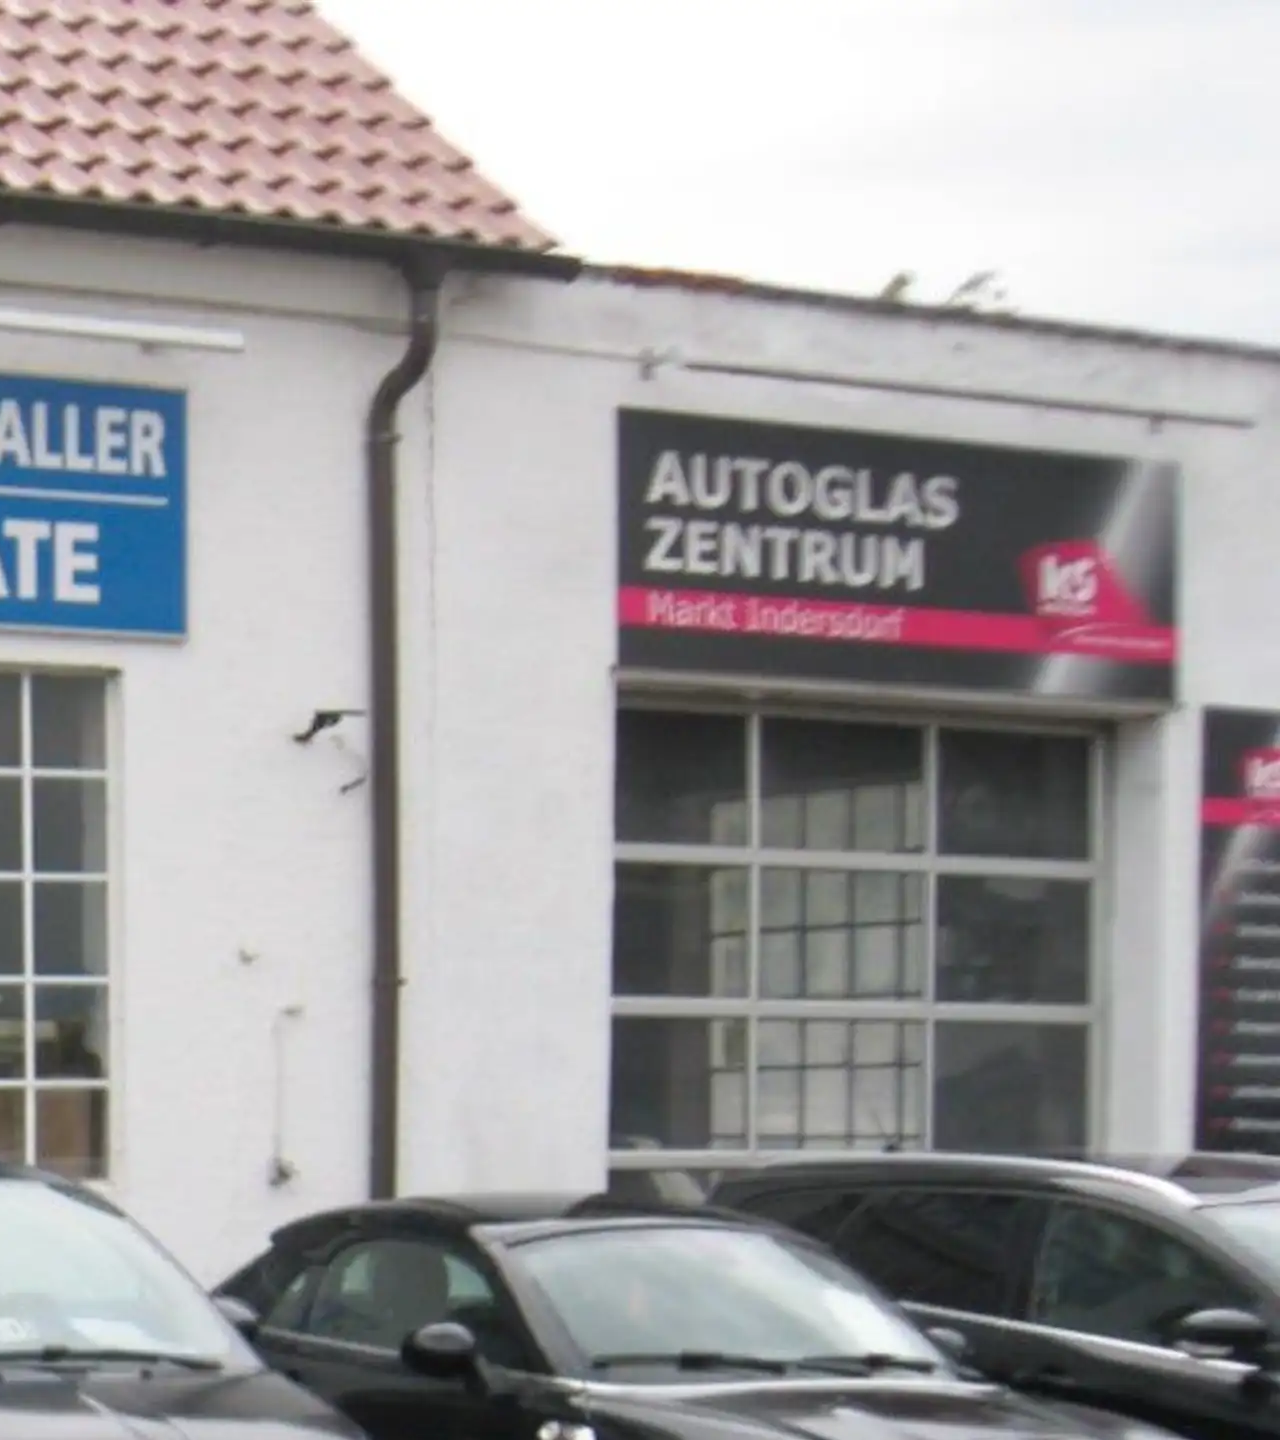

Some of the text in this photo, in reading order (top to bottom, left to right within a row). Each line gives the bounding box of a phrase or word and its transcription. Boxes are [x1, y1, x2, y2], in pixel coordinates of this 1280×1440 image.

[646, 450, 960, 528] AUTOGLAS
[644, 517, 925, 591] ZENTRUM
[647, 590, 904, 641] Markt Indersdorf
